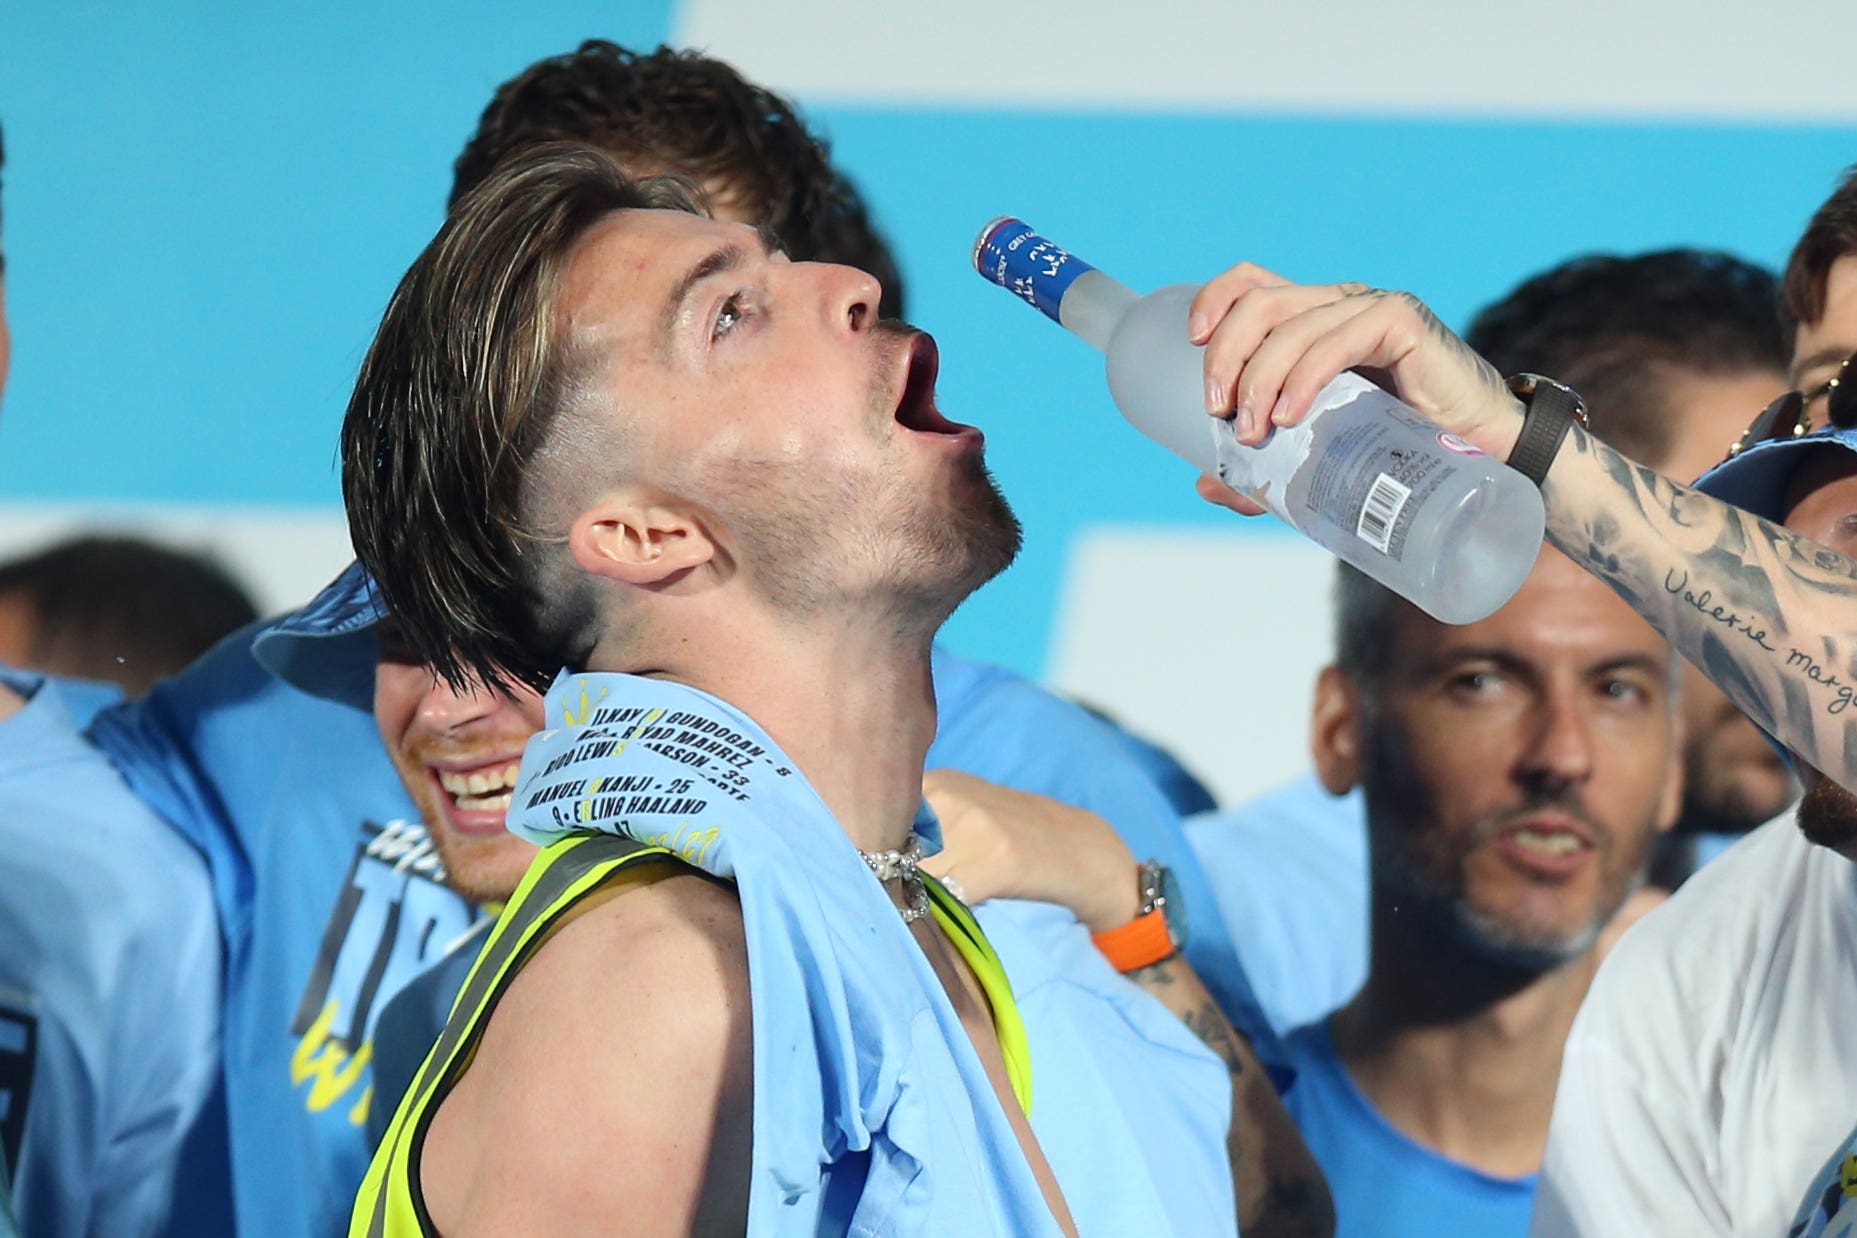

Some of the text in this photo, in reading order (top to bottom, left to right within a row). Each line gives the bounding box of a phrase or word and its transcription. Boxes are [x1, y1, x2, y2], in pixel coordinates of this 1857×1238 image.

[591, 708, 644, 727] ILKAY
[666, 711, 766, 757] GUNDOGAN
[574, 740, 629, 764] LEWIS
[673, 730, 754, 770] MAHREZ
[721, 769, 751, 786] 33
[525, 779, 588, 810] MANUEL
[664, 778, 696, 794] 25
[624, 796, 708, 815] HAALAND
